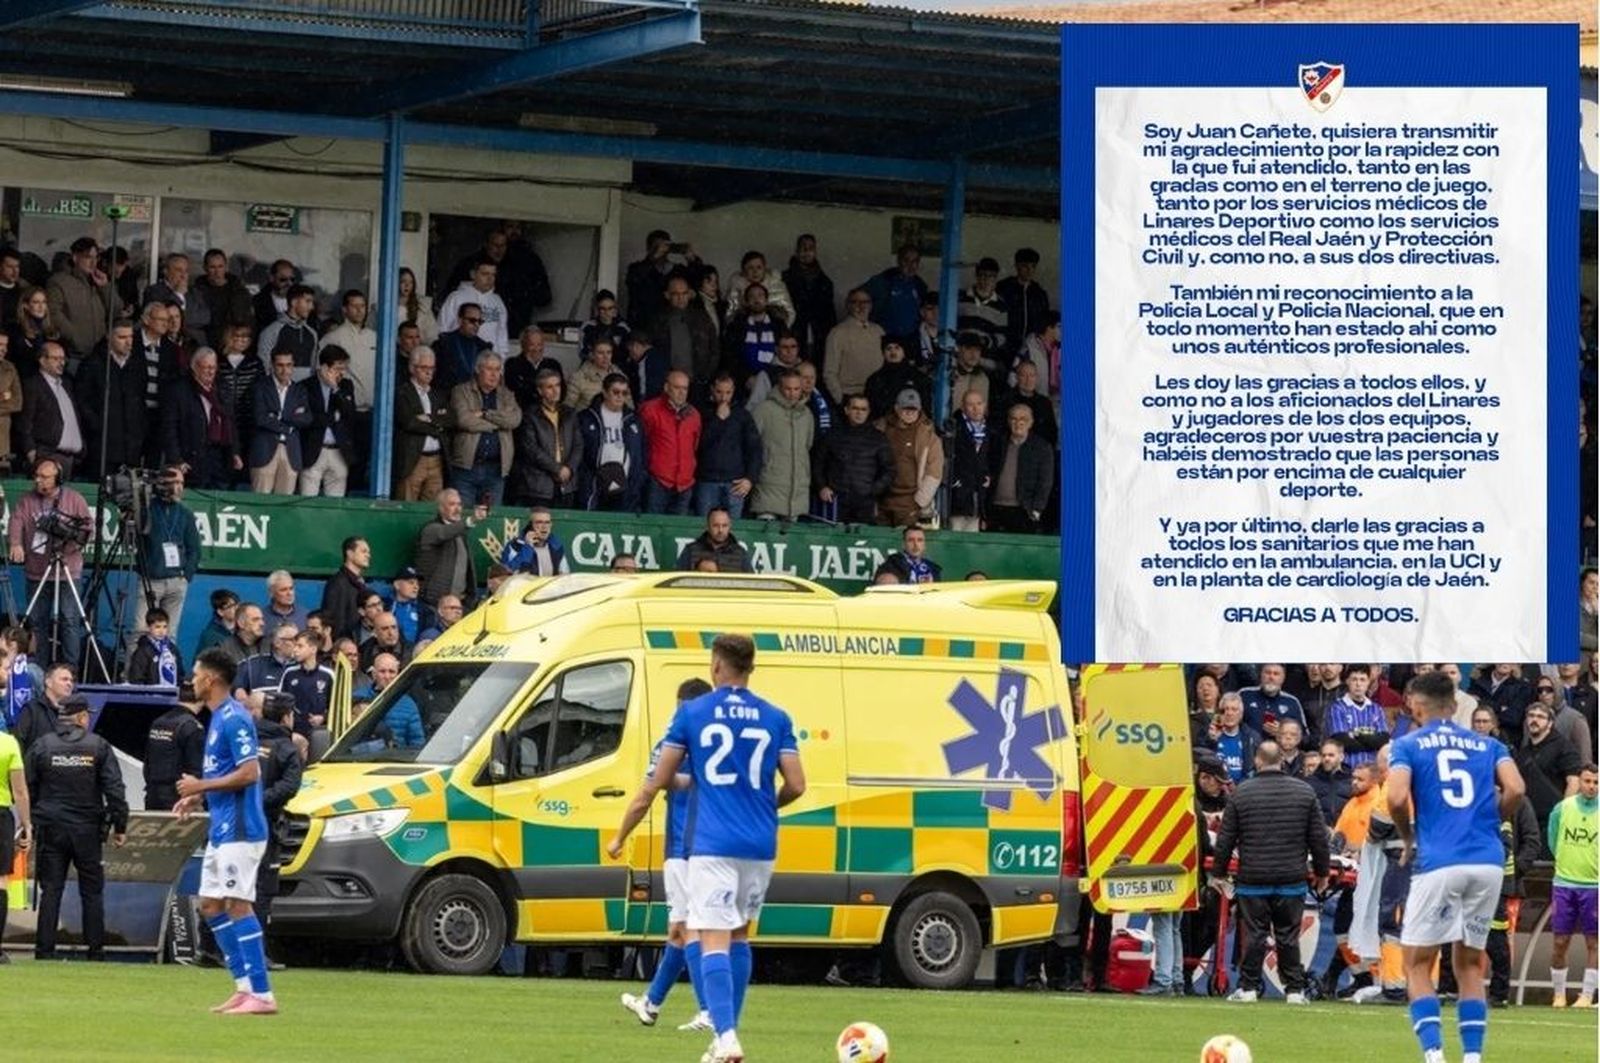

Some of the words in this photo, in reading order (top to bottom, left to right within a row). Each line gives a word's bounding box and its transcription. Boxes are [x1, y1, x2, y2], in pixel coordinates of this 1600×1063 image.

[193, 505, 270, 550] AÉN
[783, 634, 899, 656] AMBULANCIA
[729, 706, 760, 721] COVA
[700, 723, 772, 790] 27
[1437, 749, 1475, 808] 5
[1015, 844, 1058, 867] 112
